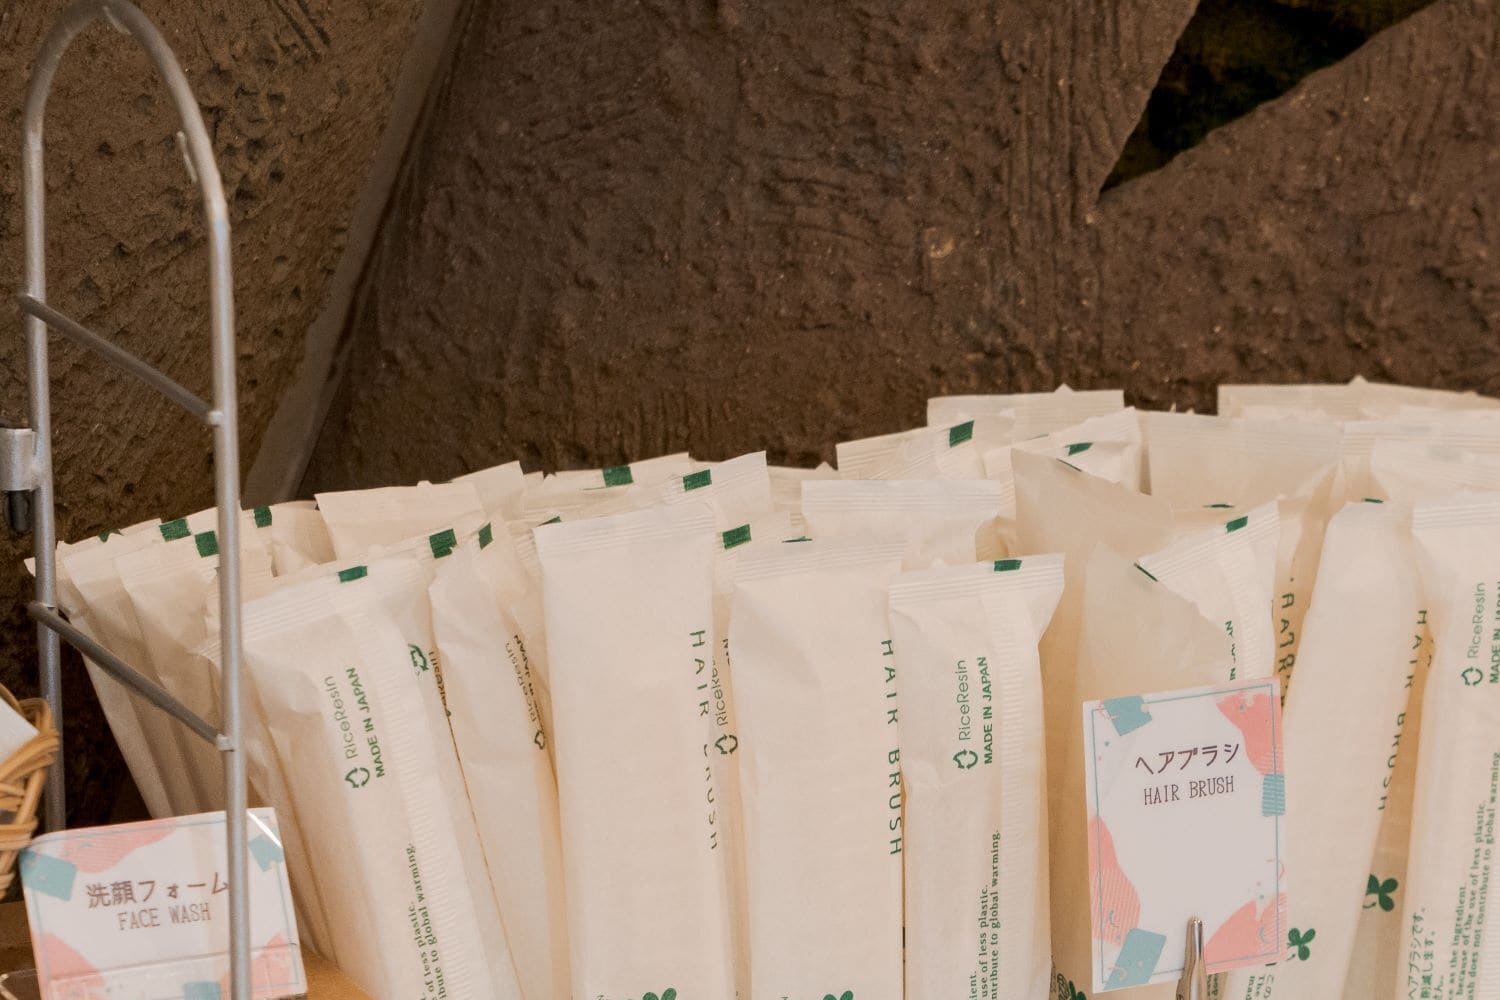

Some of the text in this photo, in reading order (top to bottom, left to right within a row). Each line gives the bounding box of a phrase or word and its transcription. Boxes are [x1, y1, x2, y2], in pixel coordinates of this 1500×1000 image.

[1467, 582, 1485, 659] RiceResin
[1405, 610, 1427, 688] HAIR
[1489, 645, 1500, 684] MADE
[689, 630, 711, 717] HAIR
[955, 660, 971, 740] RiceResin
[977, 657, 993, 764] MADE IN JAPAN
[325, 676, 358, 759] RiceResin
[346, 668, 385, 778] MADE IN JAPAN
[881, 640, 905, 855] HAIR BRUSH
[1135, 743, 1239, 775] ヘアブラシ
[1144, 776, 1234, 805] HAIR BRUSH
[1482, 809, 1495, 845] global
[990, 830, 1002, 886] warming.
[1469, 848, 1482, 869] less
[1482, 848, 1492, 860] to
[87, 872, 229, 908] 洗顔フォーム
[406, 844, 425, 902] warming.
[1468, 873, 1479, 886] of
[978, 885, 990, 927] plastic.
[988, 891, 1001, 928] global
[1468, 890, 1477, 908] use
[1474, 865, 1490, 925] contribute
[118, 902, 211, 931] FACE WASH
[408, 902, 426, 948] plastic.
[418, 906, 437, 945] global
[1461, 914, 1474, 931] the
[978, 933, 988, 955] less
[989, 933, 999, 945] to
[1461, 933, 1470, 946] of
[1472, 929, 1483, 947] not
[420, 952, 432, 977] less
[430, 950, 440, 962] to
[978, 960, 989, 972] of
[1448, 950, 1458, 968] the
[1455, 950, 1468, 995] because
[1467, 952, 1480, 977] does
[424, 980, 435, 993] of
[980, 977, 989, 997] use
